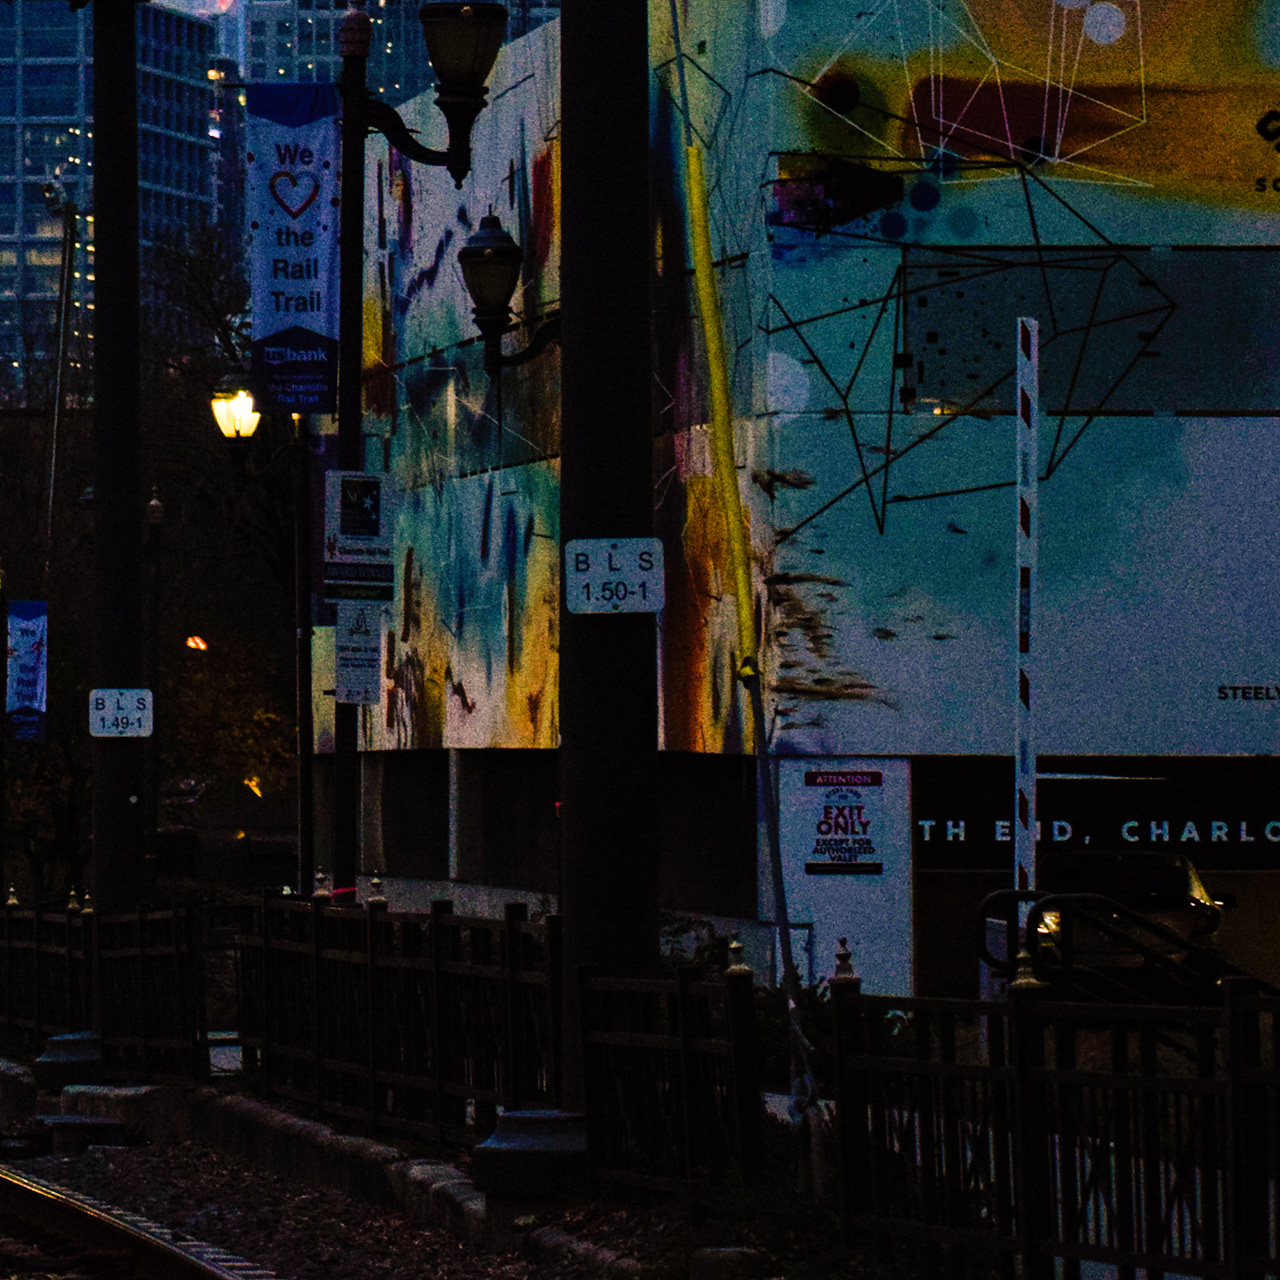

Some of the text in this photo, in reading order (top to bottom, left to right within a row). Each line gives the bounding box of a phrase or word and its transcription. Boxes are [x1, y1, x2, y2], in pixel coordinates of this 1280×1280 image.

[275, 144, 314, 165] We
[275, 226, 315, 247] the
[273, 258, 318, 280] Rail
[271, 291, 321, 312] Trail
[582, 581, 647, 601] 1.50-1
[100, 716, 142, 729] 1.49-1
[816, 775, 872, 784] ATTENTION
[823, 805, 865, 821] EXIT
[816, 820, 870, 835] ONLY
[995, 820, 1091, 845] ED,
[813, 846, 875, 855] AUTHORIZED
[816, 838, 872, 847] EXCEPT FOR
[830, 854, 858, 862] VALET
